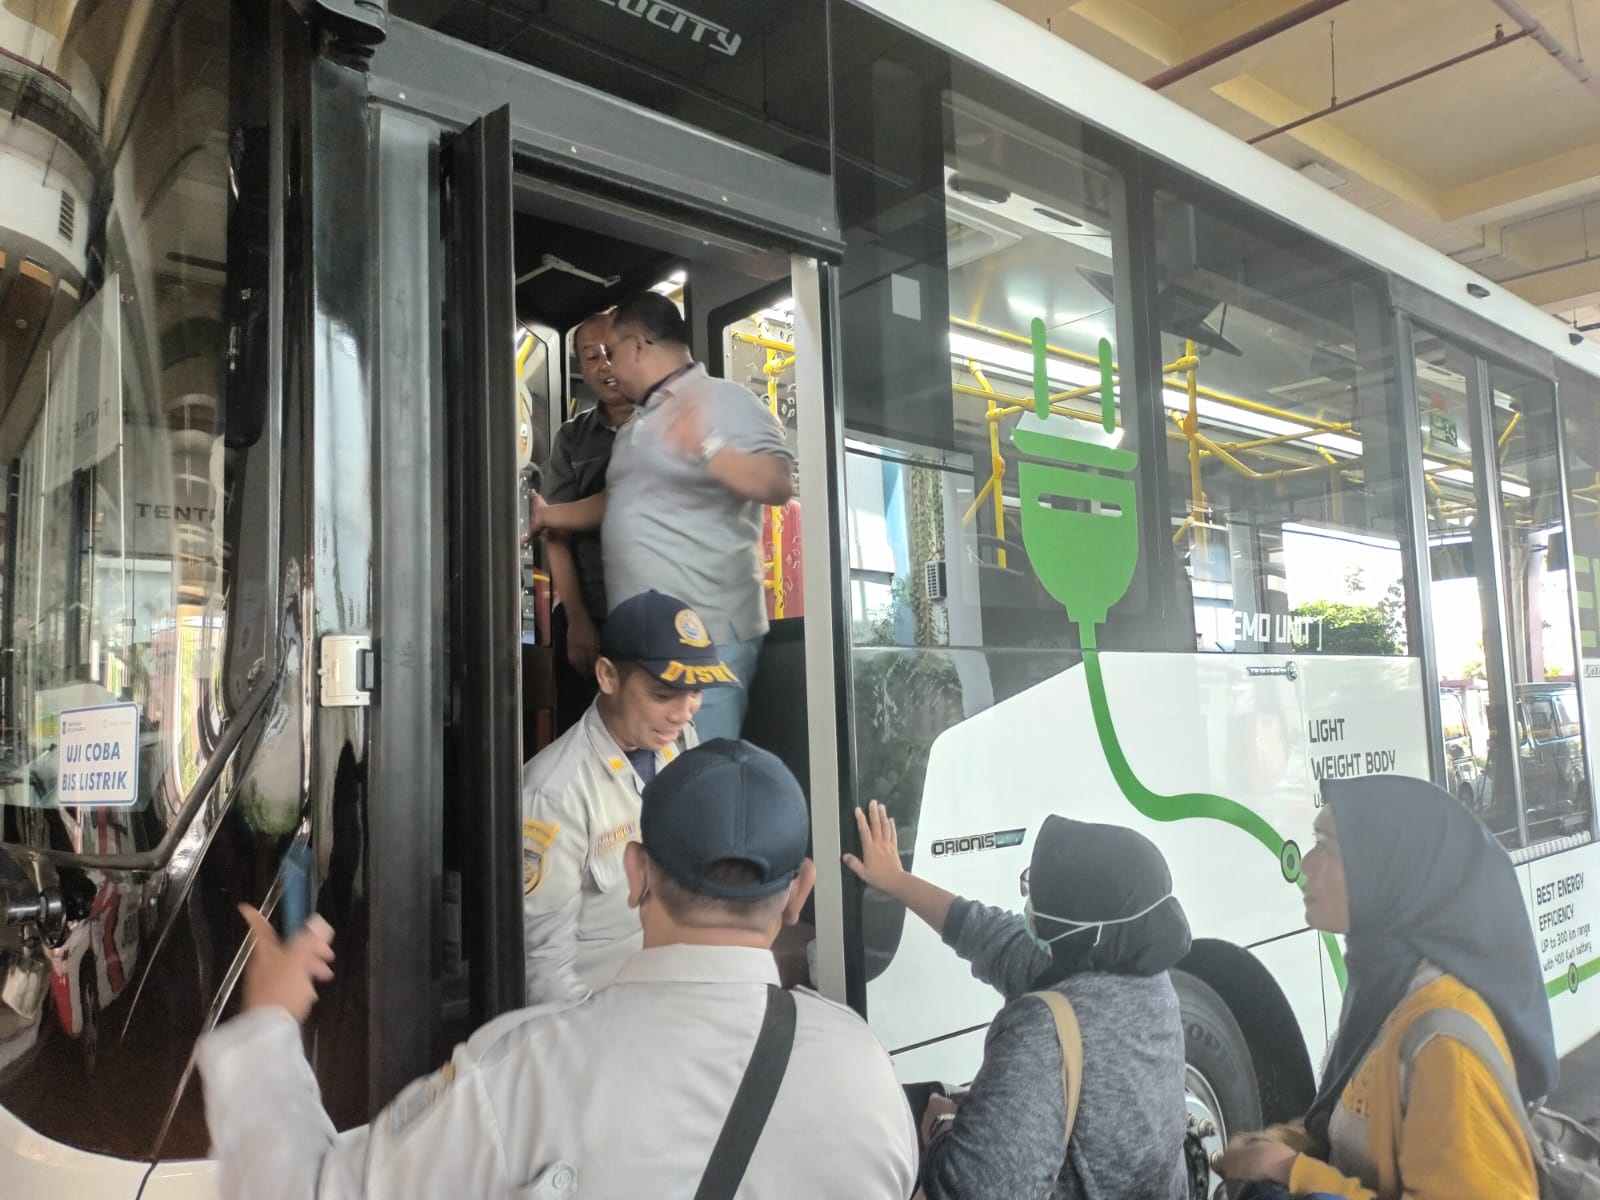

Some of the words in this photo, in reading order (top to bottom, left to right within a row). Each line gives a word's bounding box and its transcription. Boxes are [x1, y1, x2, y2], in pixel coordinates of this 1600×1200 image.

[1308, 718, 1345, 743] LIGHT
[66, 744, 82, 763] UJI
[85, 741, 121, 762] COBA
[1310, 753, 1361, 781] WEIGHT
[1365, 749, 1396, 774] BODY
[62, 773, 77, 791] BIS
[80, 770, 128, 791] LISTRIK
[933, 834, 994, 856] ORIONIS
[1536, 882, 1556, 906] BEST
[1557, 871, 1584, 898] ENERGY
[1539, 903, 1574, 931] EFFICIENCY
[1557, 930, 1568, 946] 300
[1577, 923, 1591, 937] range
[1576, 941, 1592, 956] battery
